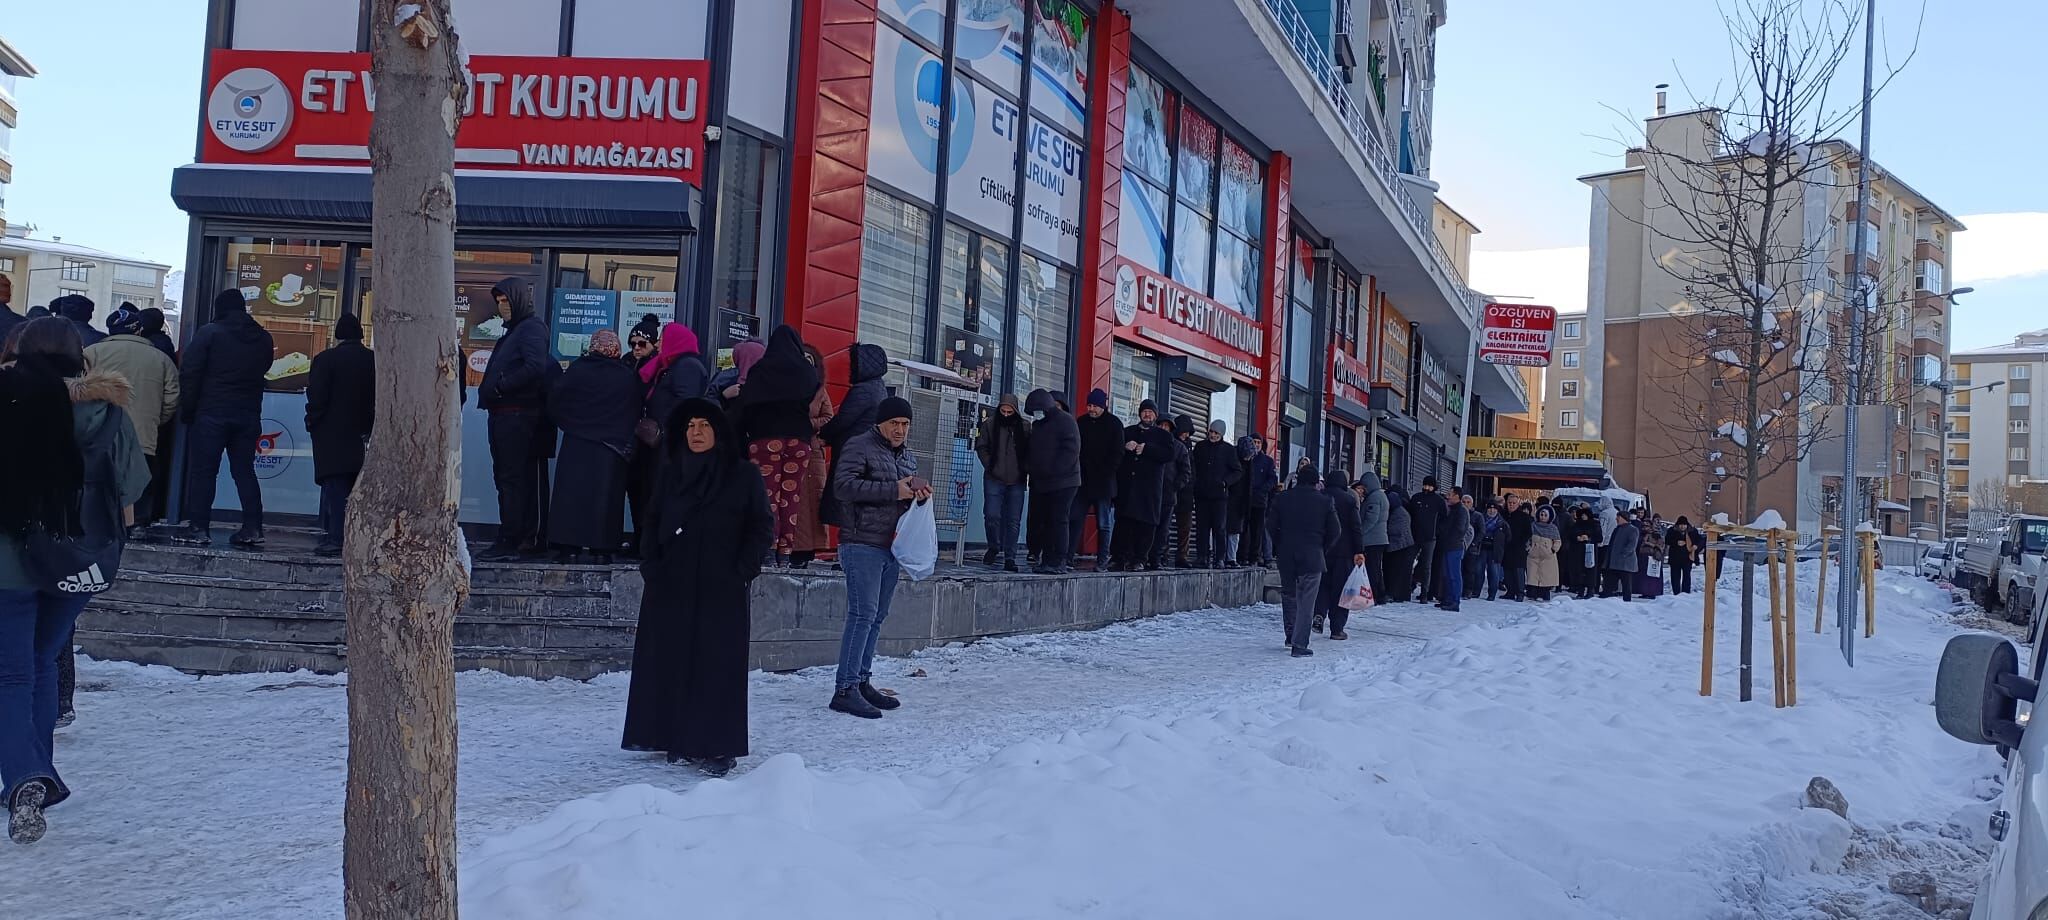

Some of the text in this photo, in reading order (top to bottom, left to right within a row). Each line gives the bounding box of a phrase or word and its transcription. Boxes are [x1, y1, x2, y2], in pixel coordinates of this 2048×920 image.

[302, 69, 355, 113] ET
[509, 74, 698, 122] KURUMU
[216, 120, 276, 132] ET VE SÜT
[992, 98, 1018, 142] ET
[229, 132, 260, 140] KURUMU
[522, 142, 693, 170] VAN MAĞAZASI
[979, 176, 1080, 239] Çiftlikte sofraya güve
[1143, 275, 1264, 358] ET VE SÜT KURUMU
[1489, 304, 1551, 319] ÖZGÜVEN
[1511, 319, 1526, 328] ISI
[1487, 331, 1546, 343] ELEKTRİKLİ
[1489, 439, 1580, 453] KARDEM İNŞAAT
[1490, 450, 1514, 458] YAPI
[1517, 450, 1597, 460] MALZEMELERİ
[57, 581, 110, 592] adidas
